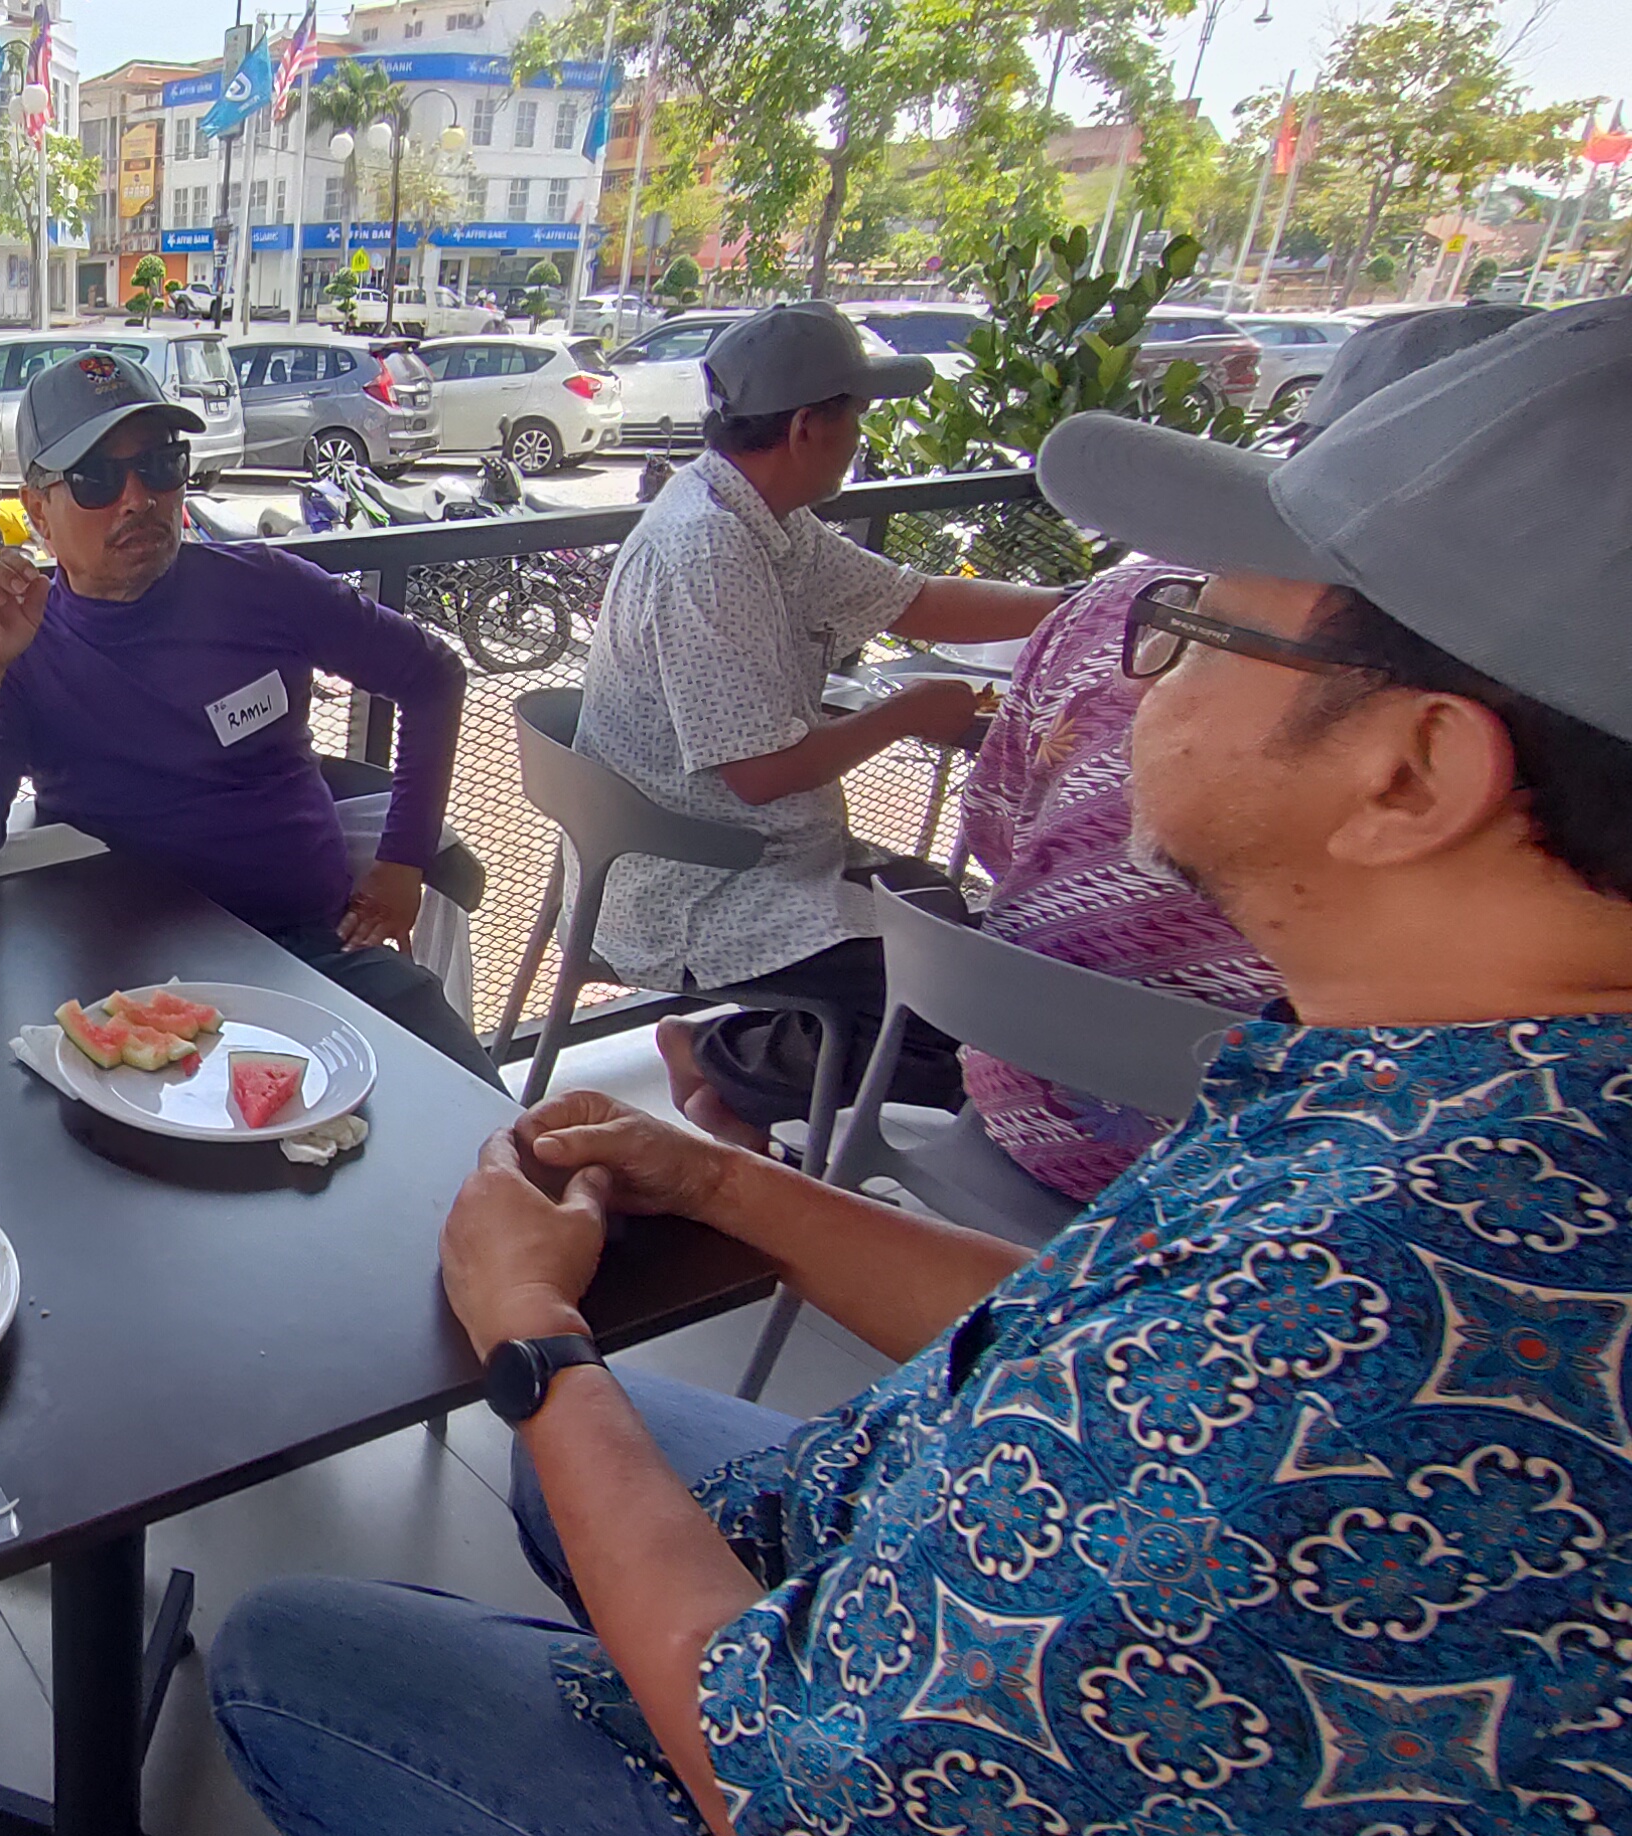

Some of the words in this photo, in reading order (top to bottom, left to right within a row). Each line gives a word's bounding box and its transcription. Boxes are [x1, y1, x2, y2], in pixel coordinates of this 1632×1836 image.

[348, 229, 369, 240] FIN
[371, 229, 392, 239] BAN
[227, 694, 273, 730] RAMLI
